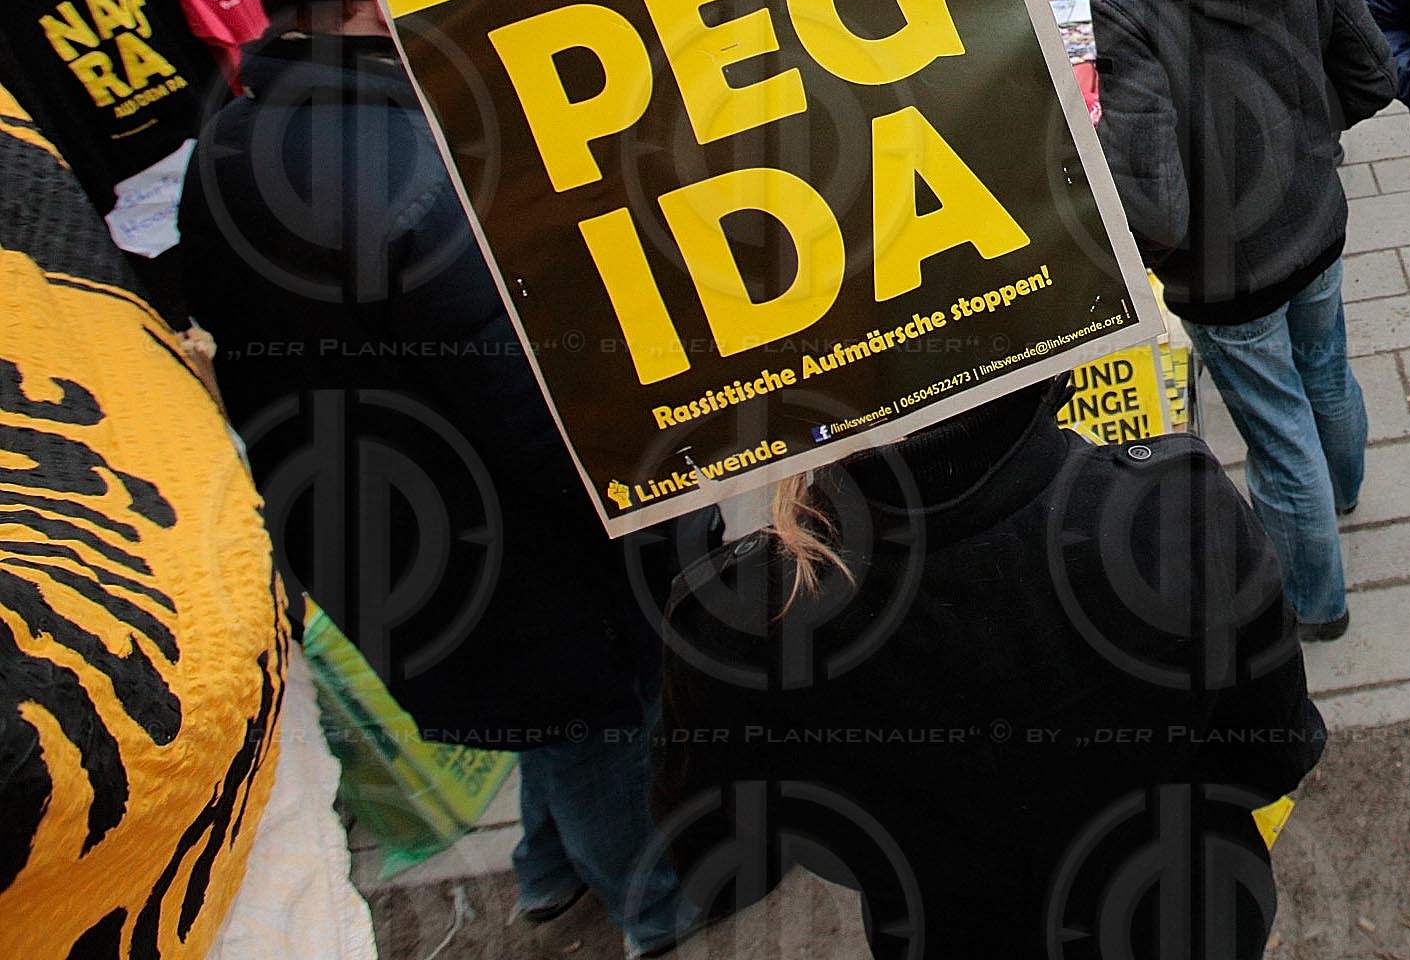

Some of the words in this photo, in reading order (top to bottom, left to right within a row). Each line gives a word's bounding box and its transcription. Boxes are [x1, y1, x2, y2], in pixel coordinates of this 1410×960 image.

[577, 105, 1031, 386] IDA
[651, 367, 798, 430] Rassistische
[801, 308, 947, 381] Aufmärsche
[949, 264, 1054, 323] stoppen!
[899, 370, 972, 410] 06504522473
[979, 311, 1124, 377] linkswende@linkswende.org
[1072, 359, 1134, 391] UND
[1056, 387, 1140, 426] INGE
[1091, 414, 1151, 444] EN!
[634, 438, 788, 504] Linkswende
